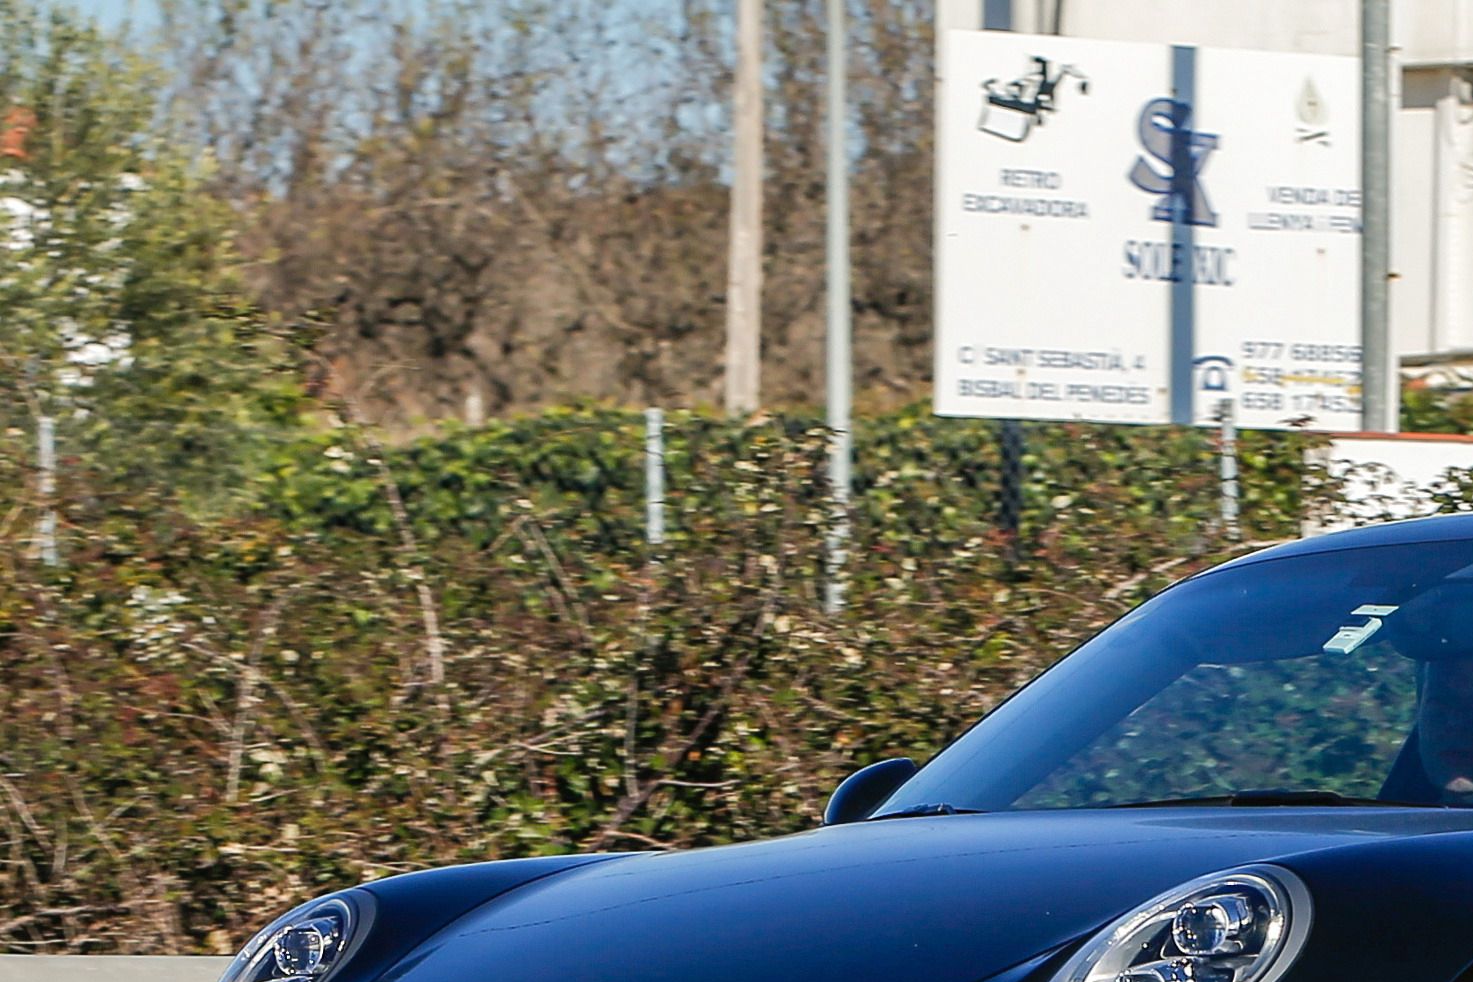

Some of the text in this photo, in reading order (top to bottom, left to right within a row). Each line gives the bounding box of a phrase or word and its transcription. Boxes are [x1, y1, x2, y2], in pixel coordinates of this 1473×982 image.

[1000, 168, 1060, 189] RETRO
[962, 193, 1089, 218] EXCAVADORA
[1266, 186, 1328, 205] VENDA
[984, 347, 1033, 366] SANT
[1132, 354, 1146, 369] 4
[1242, 341, 1284, 359] 977
[957, 379, 1022, 399] BISBAL
[1025, 381, 1062, 401] DEL
[1242, 392, 1283, 410] 658
